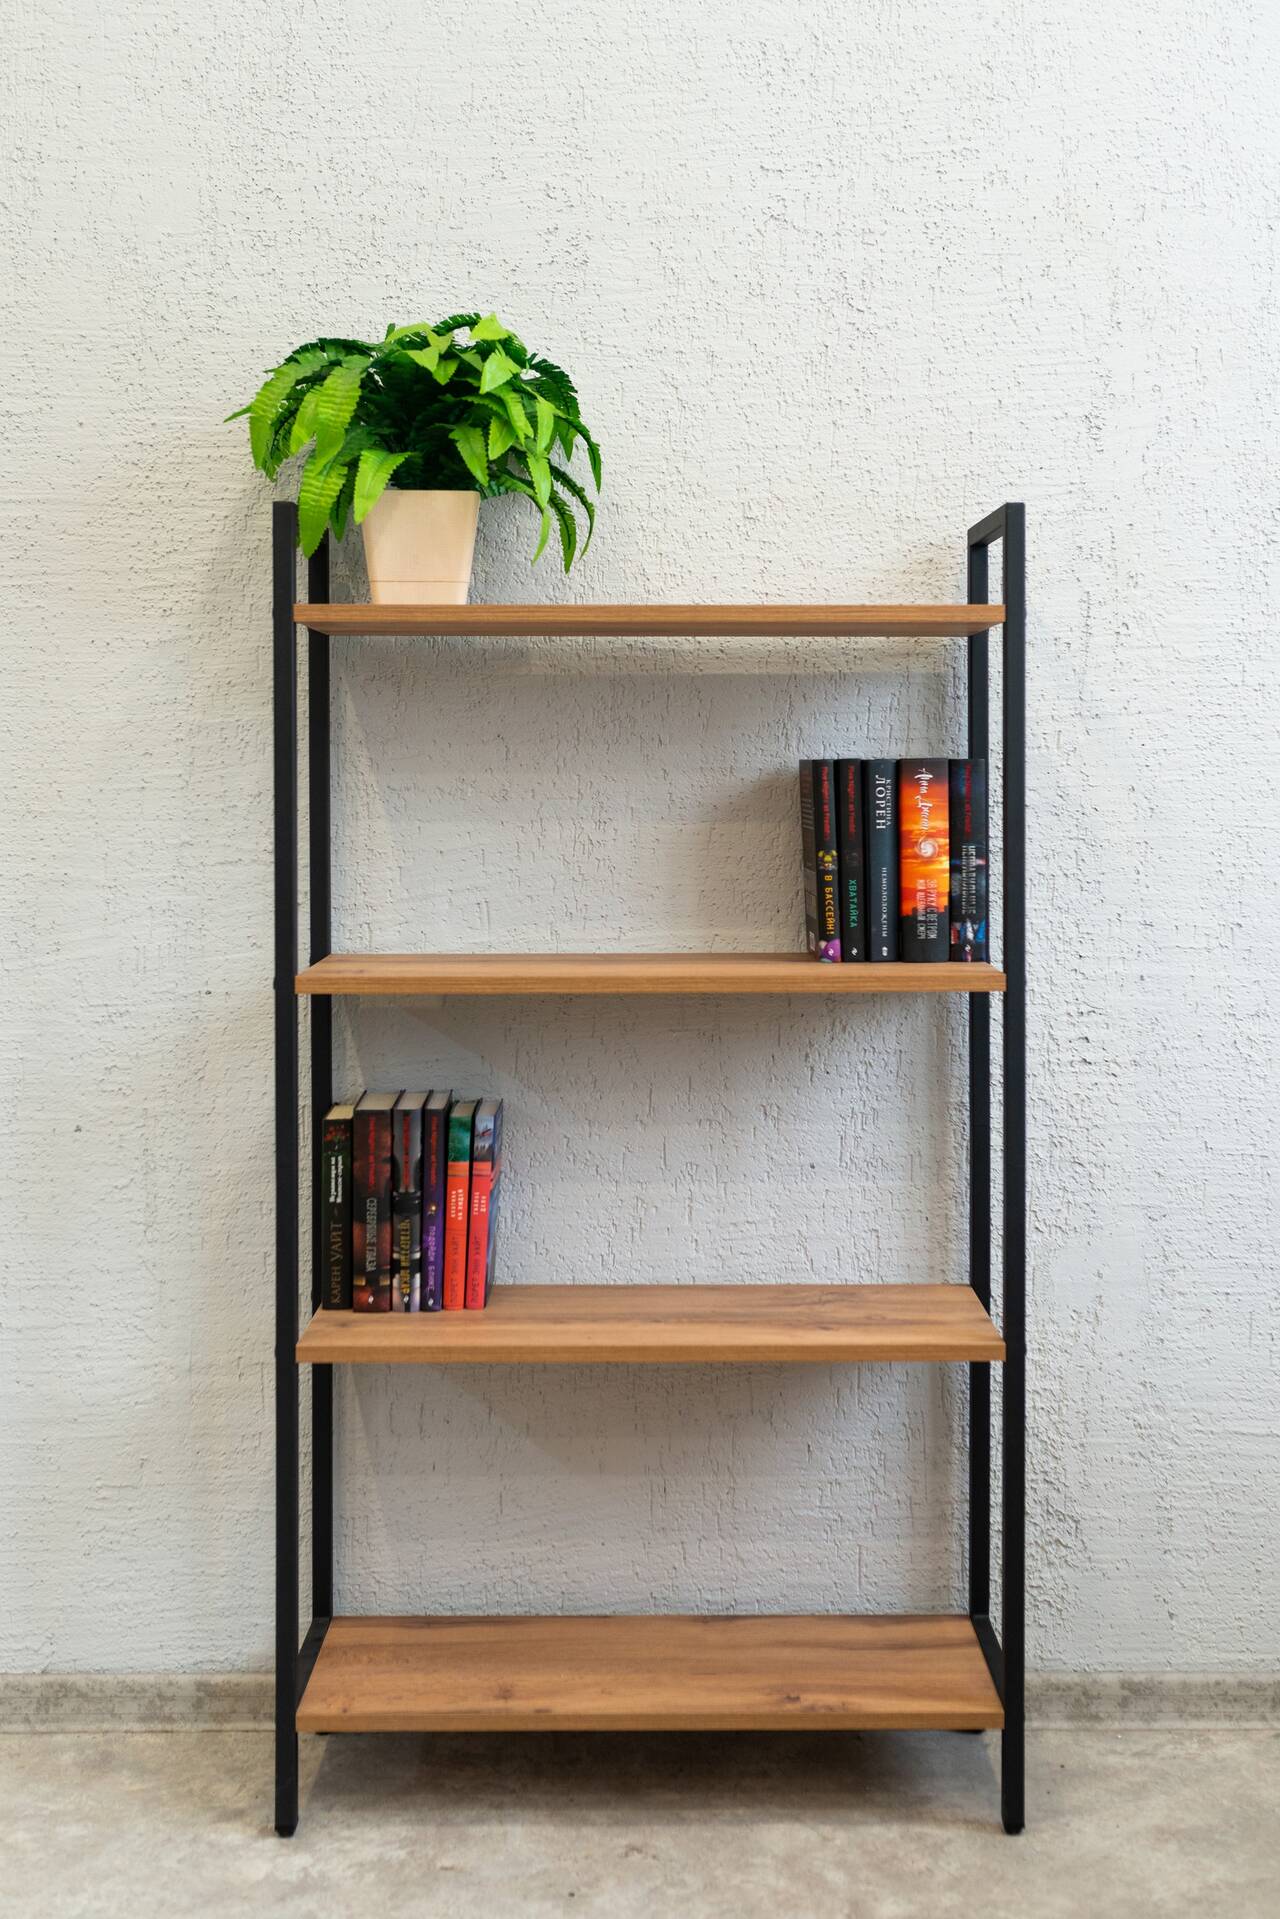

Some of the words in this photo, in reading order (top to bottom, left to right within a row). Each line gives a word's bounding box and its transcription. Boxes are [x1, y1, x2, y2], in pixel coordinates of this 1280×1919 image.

[875, 775, 886, 829] ЛОРЕН
[825, 887, 836, 936] БАССЕЙН!
[849, 879, 859, 929] ХВАТАЙКА
[926, 890, 938, 906] РУКУ
[926, 914, 938, 939] ВЕТРОМ
[329, 1221, 343, 1262] УАЙТ
[330, 1264, 342, 1304] КАРЕН
